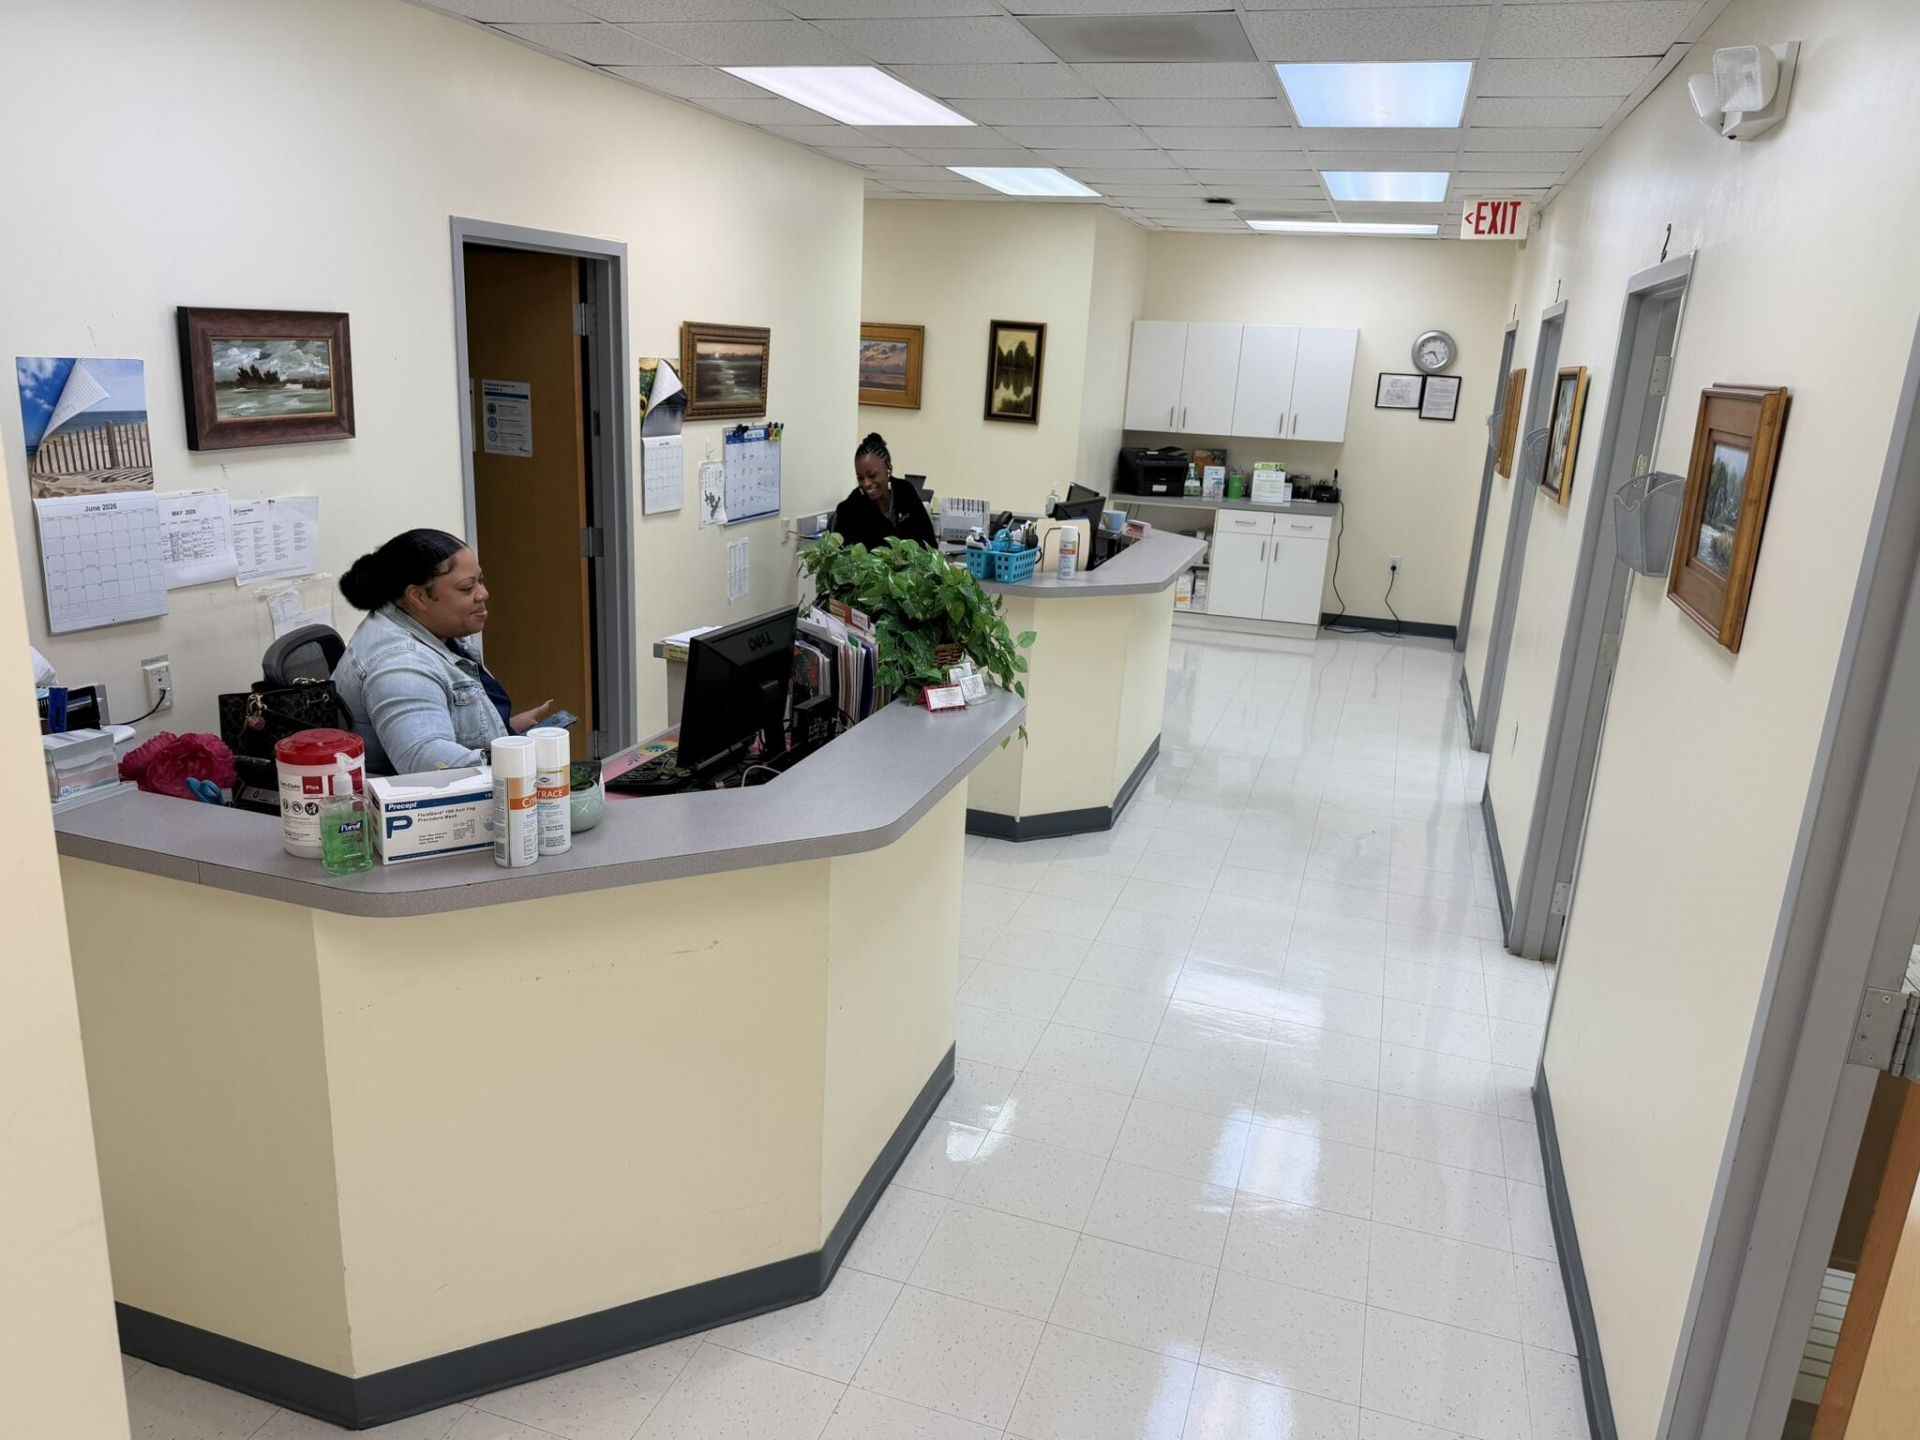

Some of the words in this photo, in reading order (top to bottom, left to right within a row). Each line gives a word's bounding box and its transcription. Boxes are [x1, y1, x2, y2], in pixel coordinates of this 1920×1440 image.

[1474, 201, 1521, 235] EXIT
[84, 505, 100, 513] June
[102, 503, 118, 511] 2026
[747, 631, 775, 652] DELL
[388, 802, 418, 811] Precept
